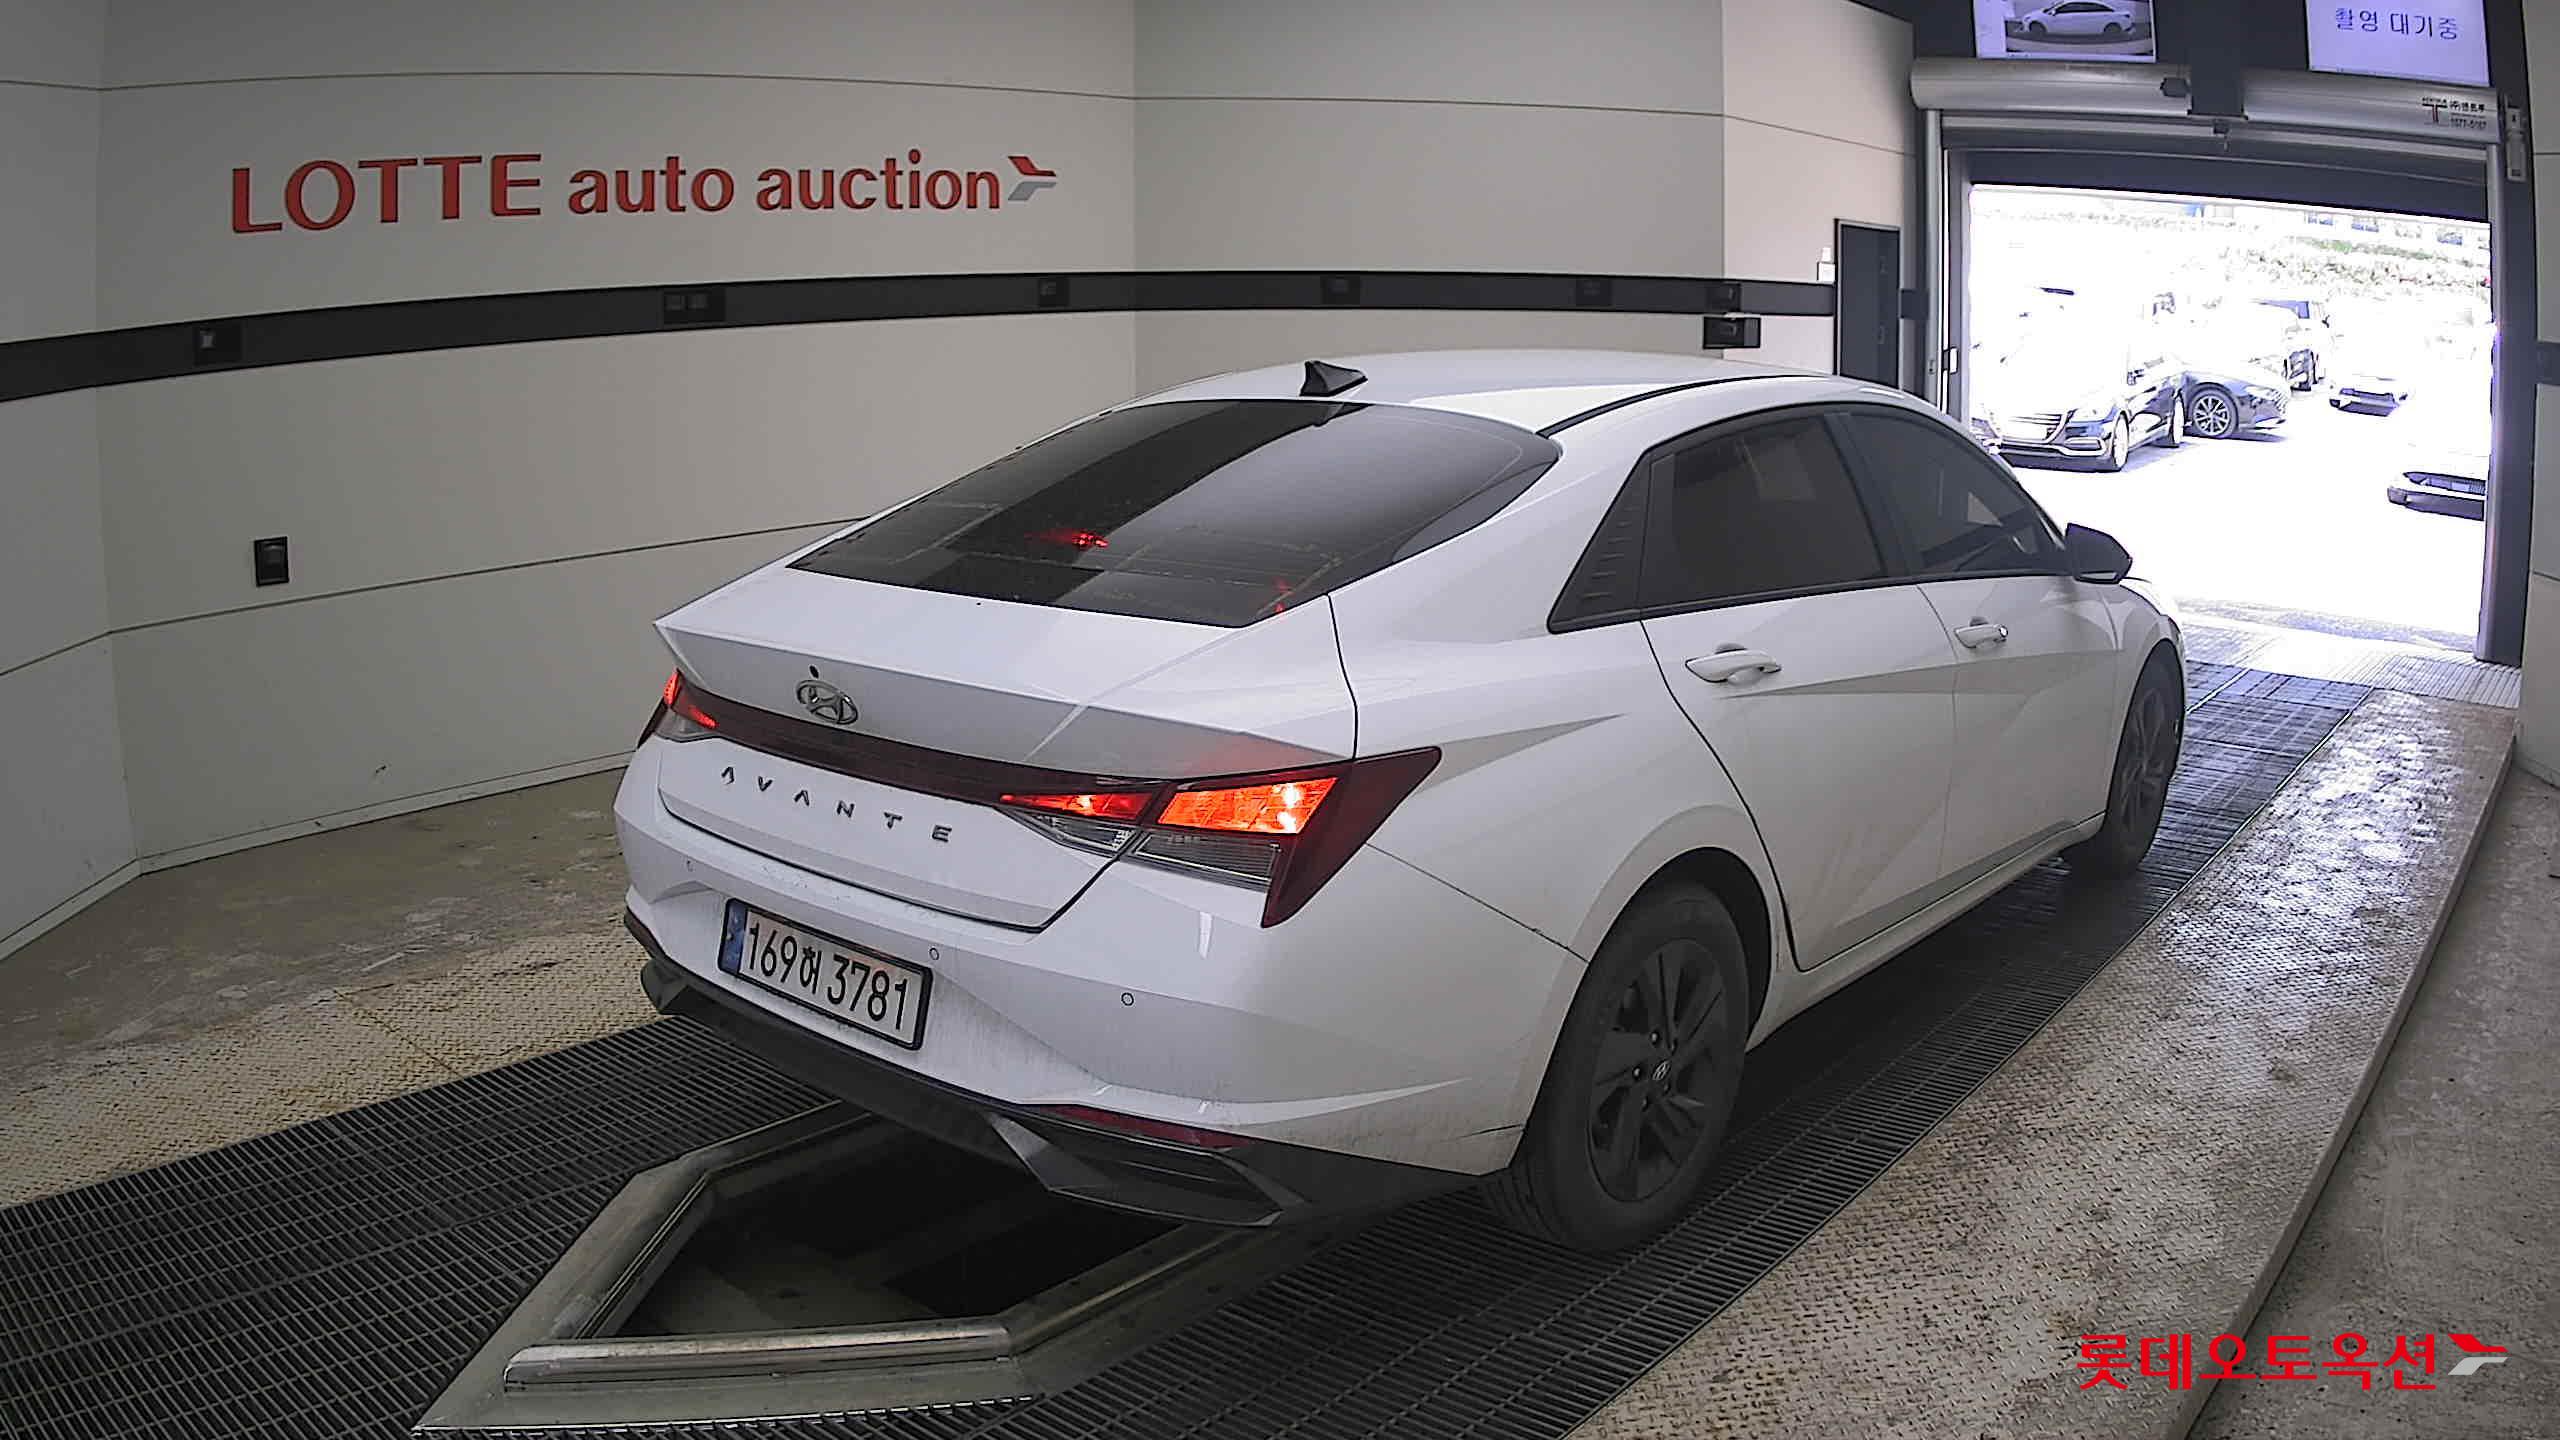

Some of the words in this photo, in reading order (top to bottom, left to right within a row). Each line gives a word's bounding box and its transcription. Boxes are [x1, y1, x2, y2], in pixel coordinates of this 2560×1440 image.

[232, 153, 542, 233] LOTTE
[569, 155, 735, 214] auto
[756, 148, 1002, 210] auction
[720, 766, 953, 843] AVANTE
[827, 953, 908, 1030] 3781
